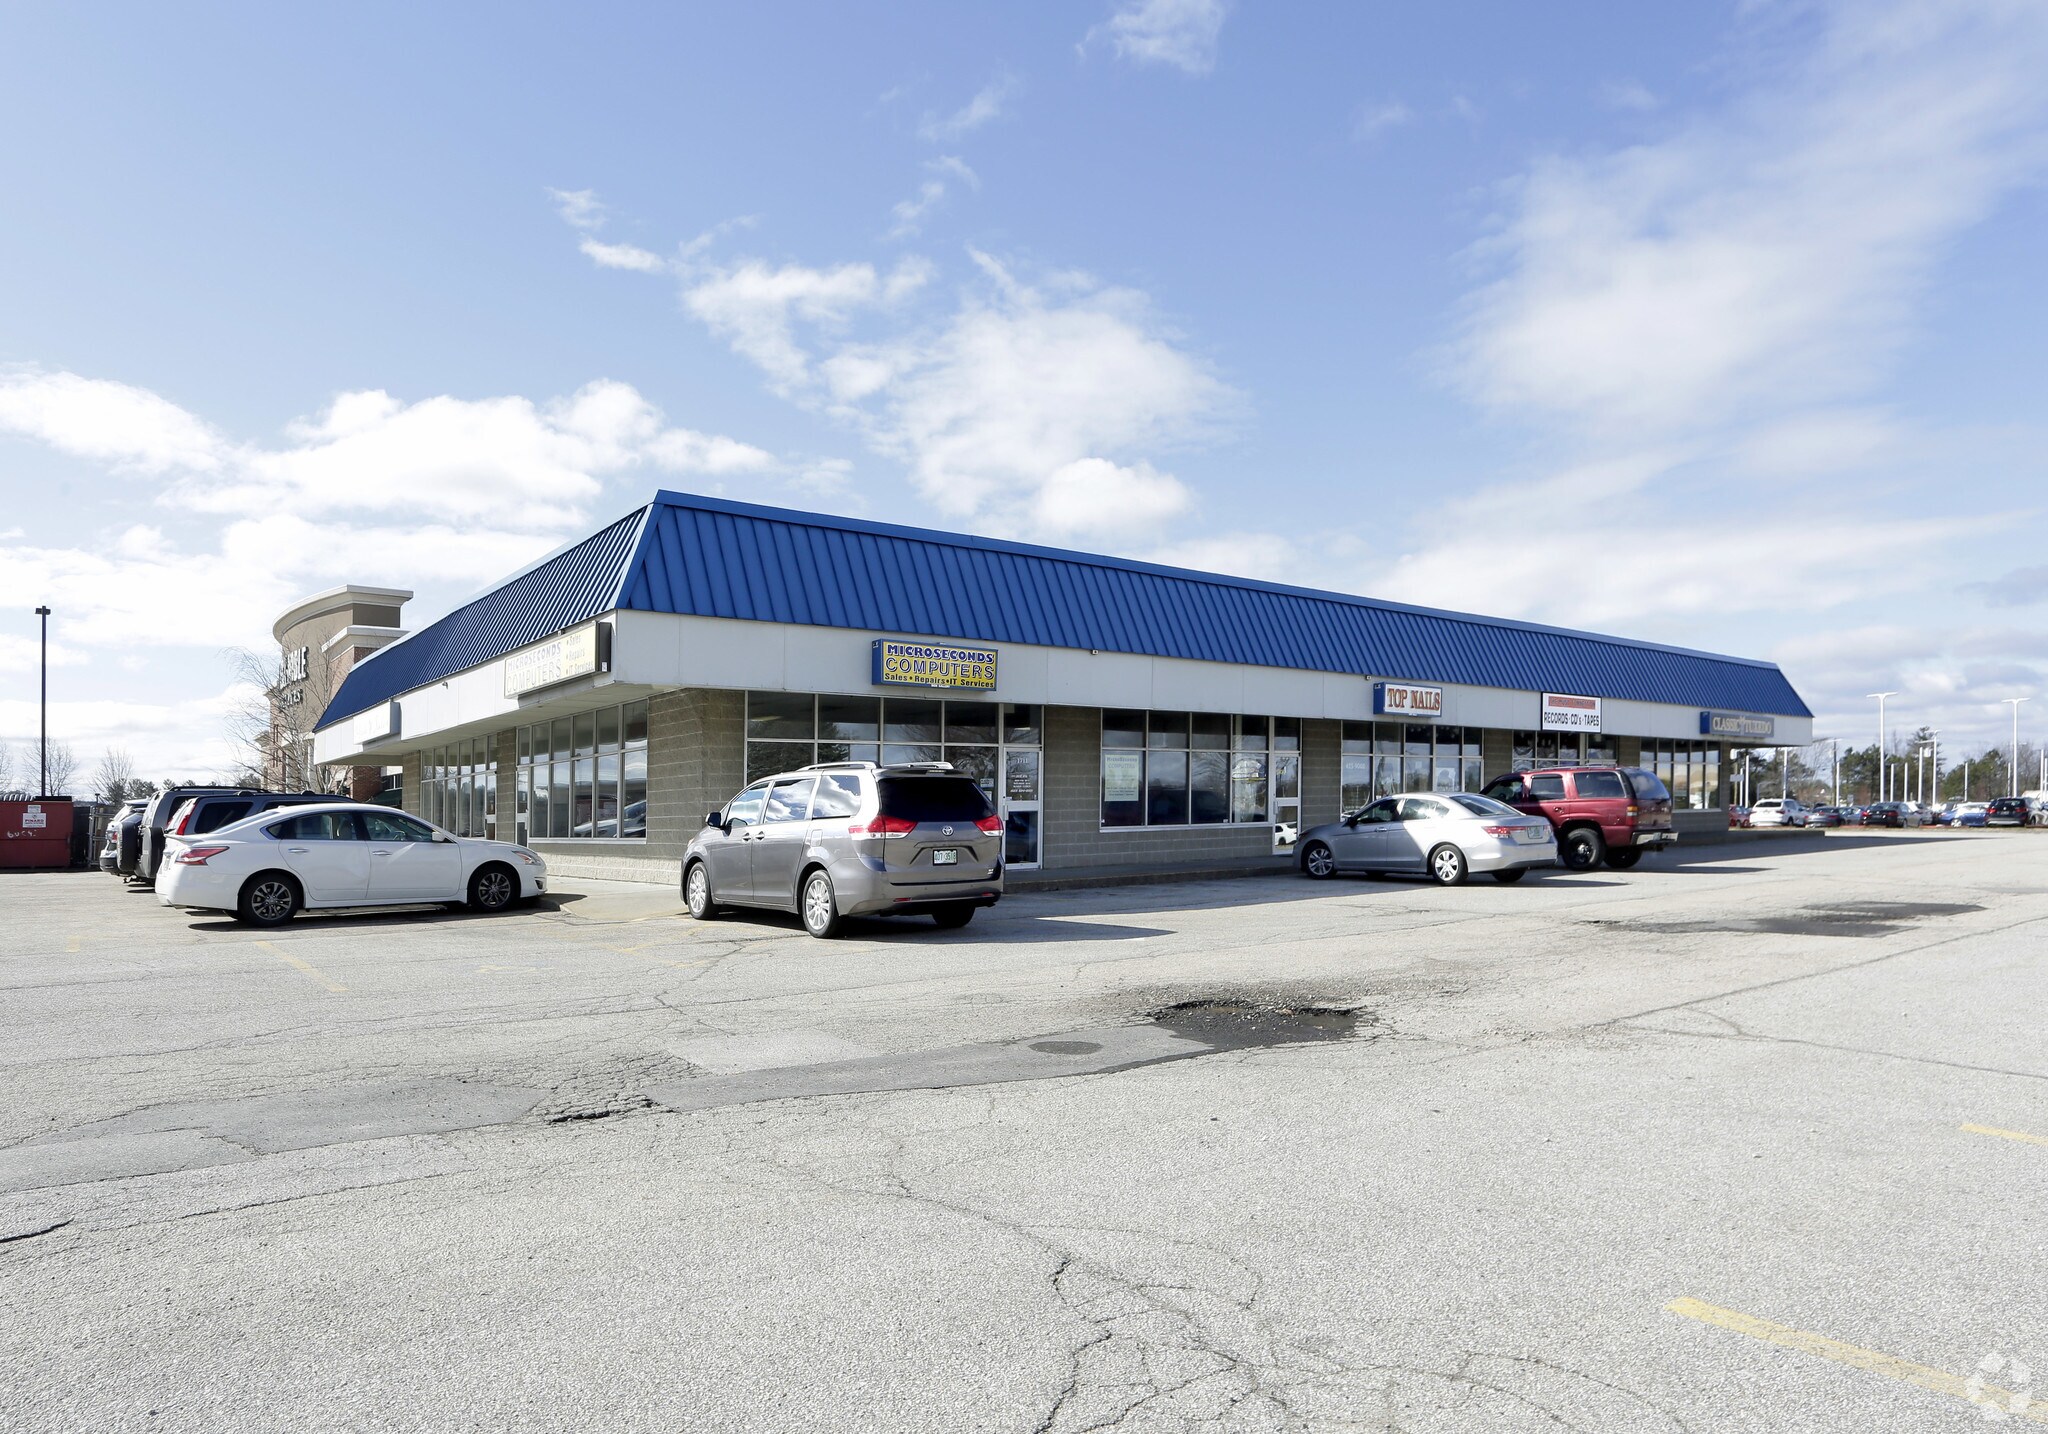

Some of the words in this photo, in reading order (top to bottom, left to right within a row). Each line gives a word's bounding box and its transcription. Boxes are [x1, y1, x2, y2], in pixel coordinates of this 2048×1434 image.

[508, 642, 561, 671] MICROSECONDS
[887, 644, 994, 664] MICROSECONDS
[506, 658, 562, 693] COMPUTERS
[886, 657, 995, 679] COMPUTERS
[885, 673, 907, 681] Sales
[914, 675, 946, 685] Repairs
[960, 679, 994, 688] Services
[1387, 688, 1407, 708] TOP
[1410, 690, 1440, 710] NAILS
[1544, 711, 1568, 724] RECORDS
[1584, 714, 1599, 726] TAPES
[1712, 717, 1740, 732] CLASSIC
[1744, 720, 1772, 734] TUXEDO
